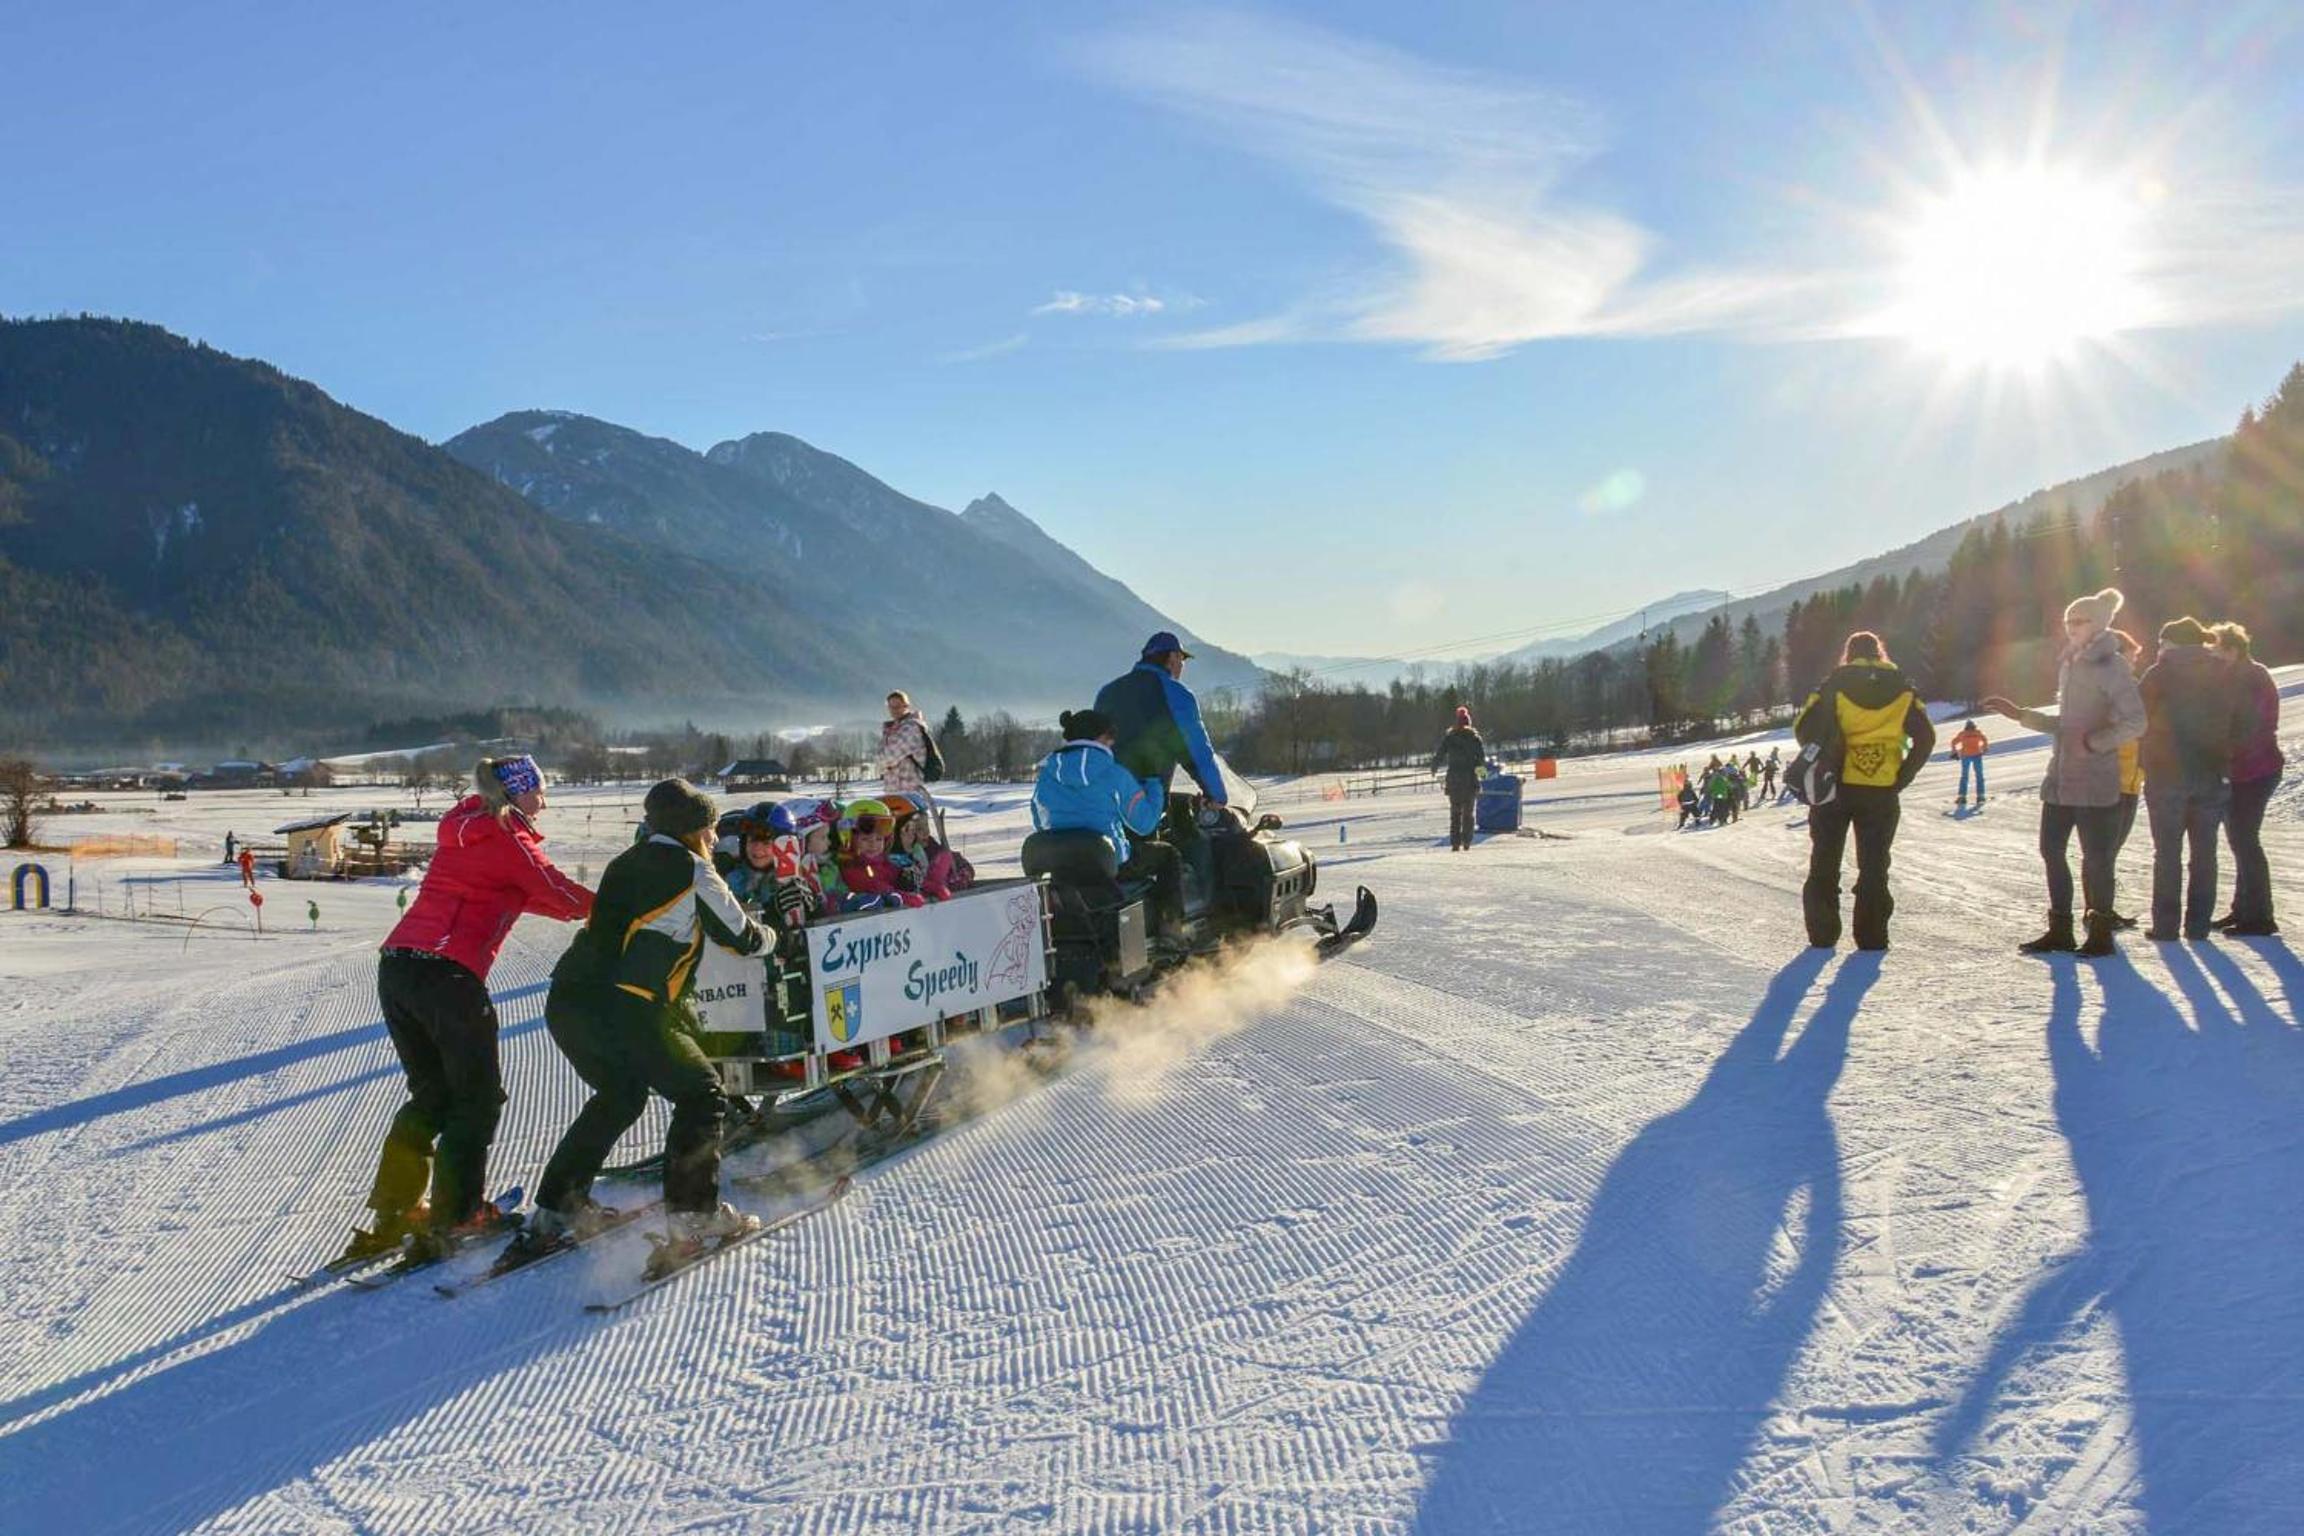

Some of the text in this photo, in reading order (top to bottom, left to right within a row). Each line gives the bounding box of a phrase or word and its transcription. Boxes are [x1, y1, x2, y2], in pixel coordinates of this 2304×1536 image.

[821, 927, 911, 974] Express
[695, 983, 747, 1003] NBACH
[904, 951, 979, 1007] Speedy
